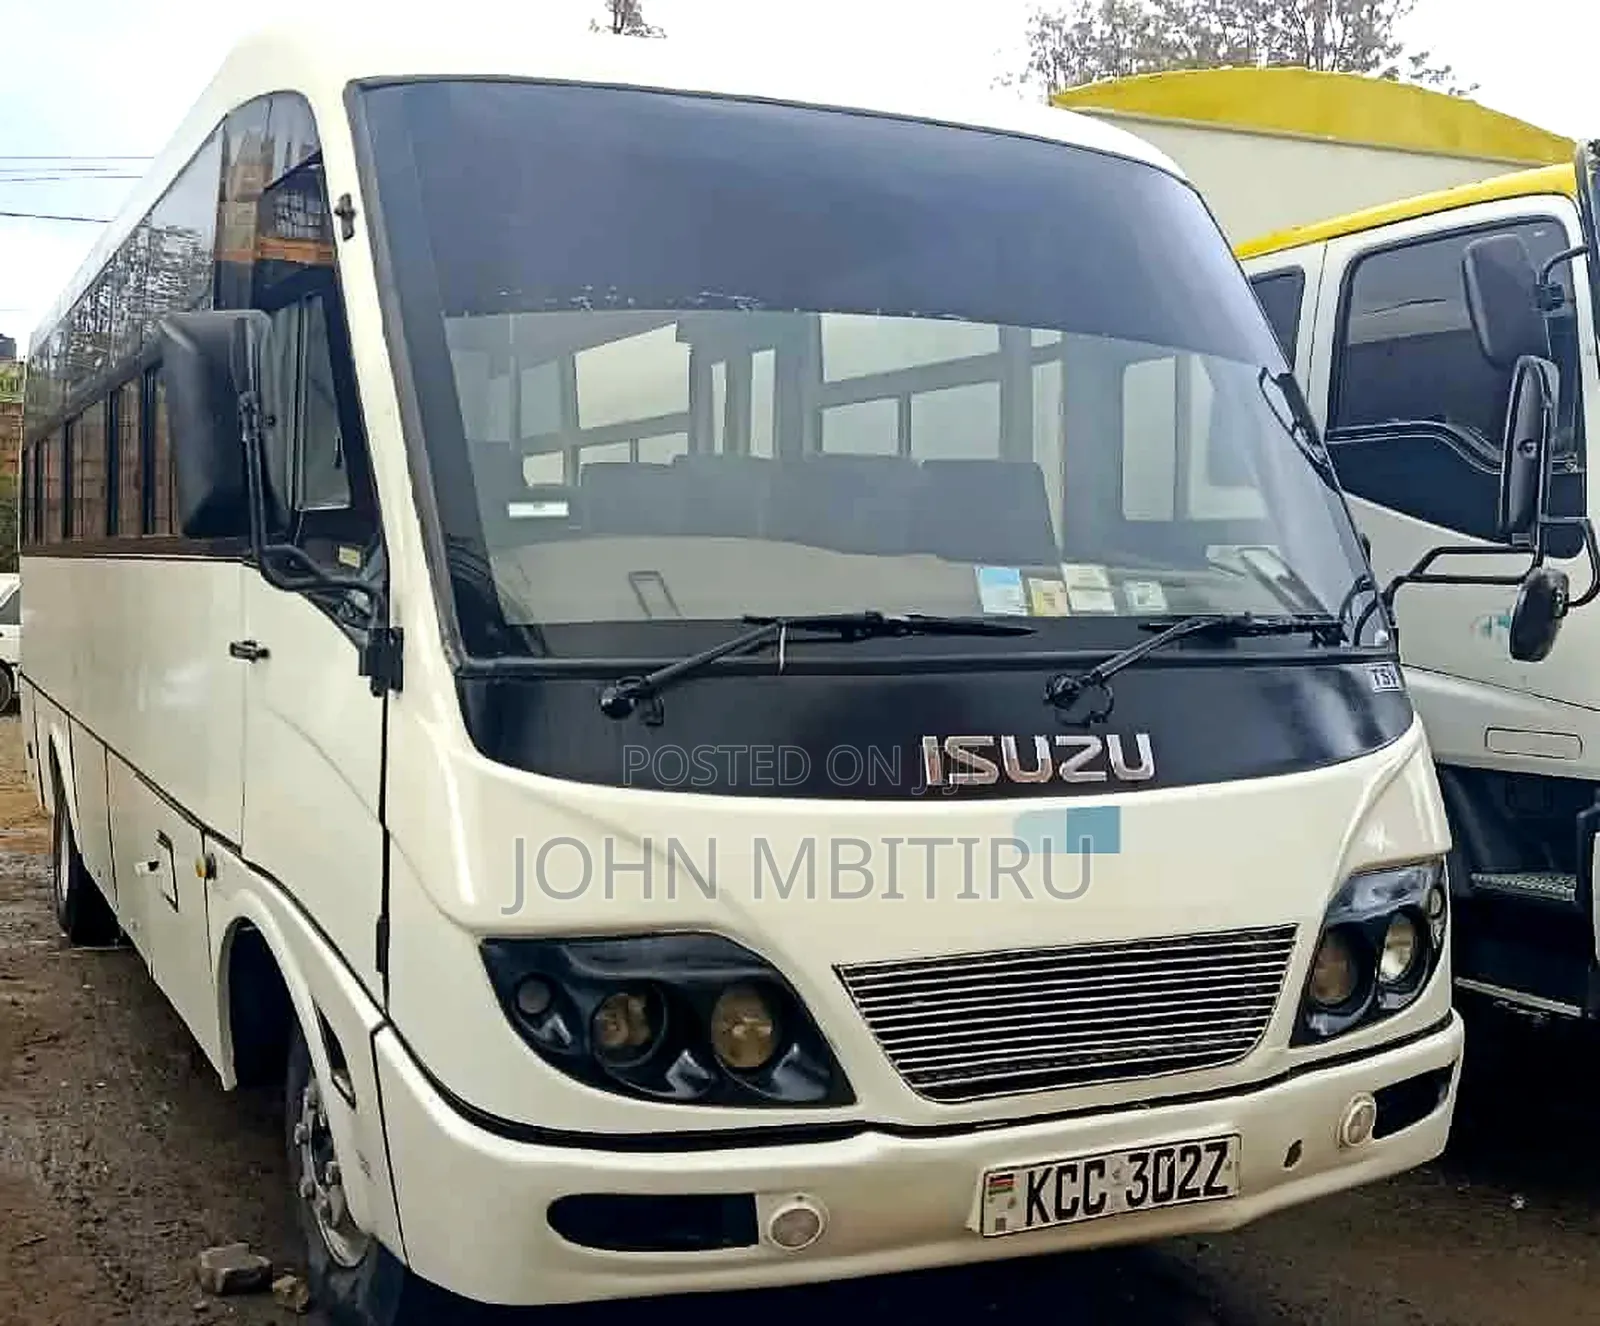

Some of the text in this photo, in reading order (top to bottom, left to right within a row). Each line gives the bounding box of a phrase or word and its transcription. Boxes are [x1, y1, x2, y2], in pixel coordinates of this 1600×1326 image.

[922, 733, 1154, 785] ISUZU
[1025, 1141, 1229, 1227] KCC 302Z
